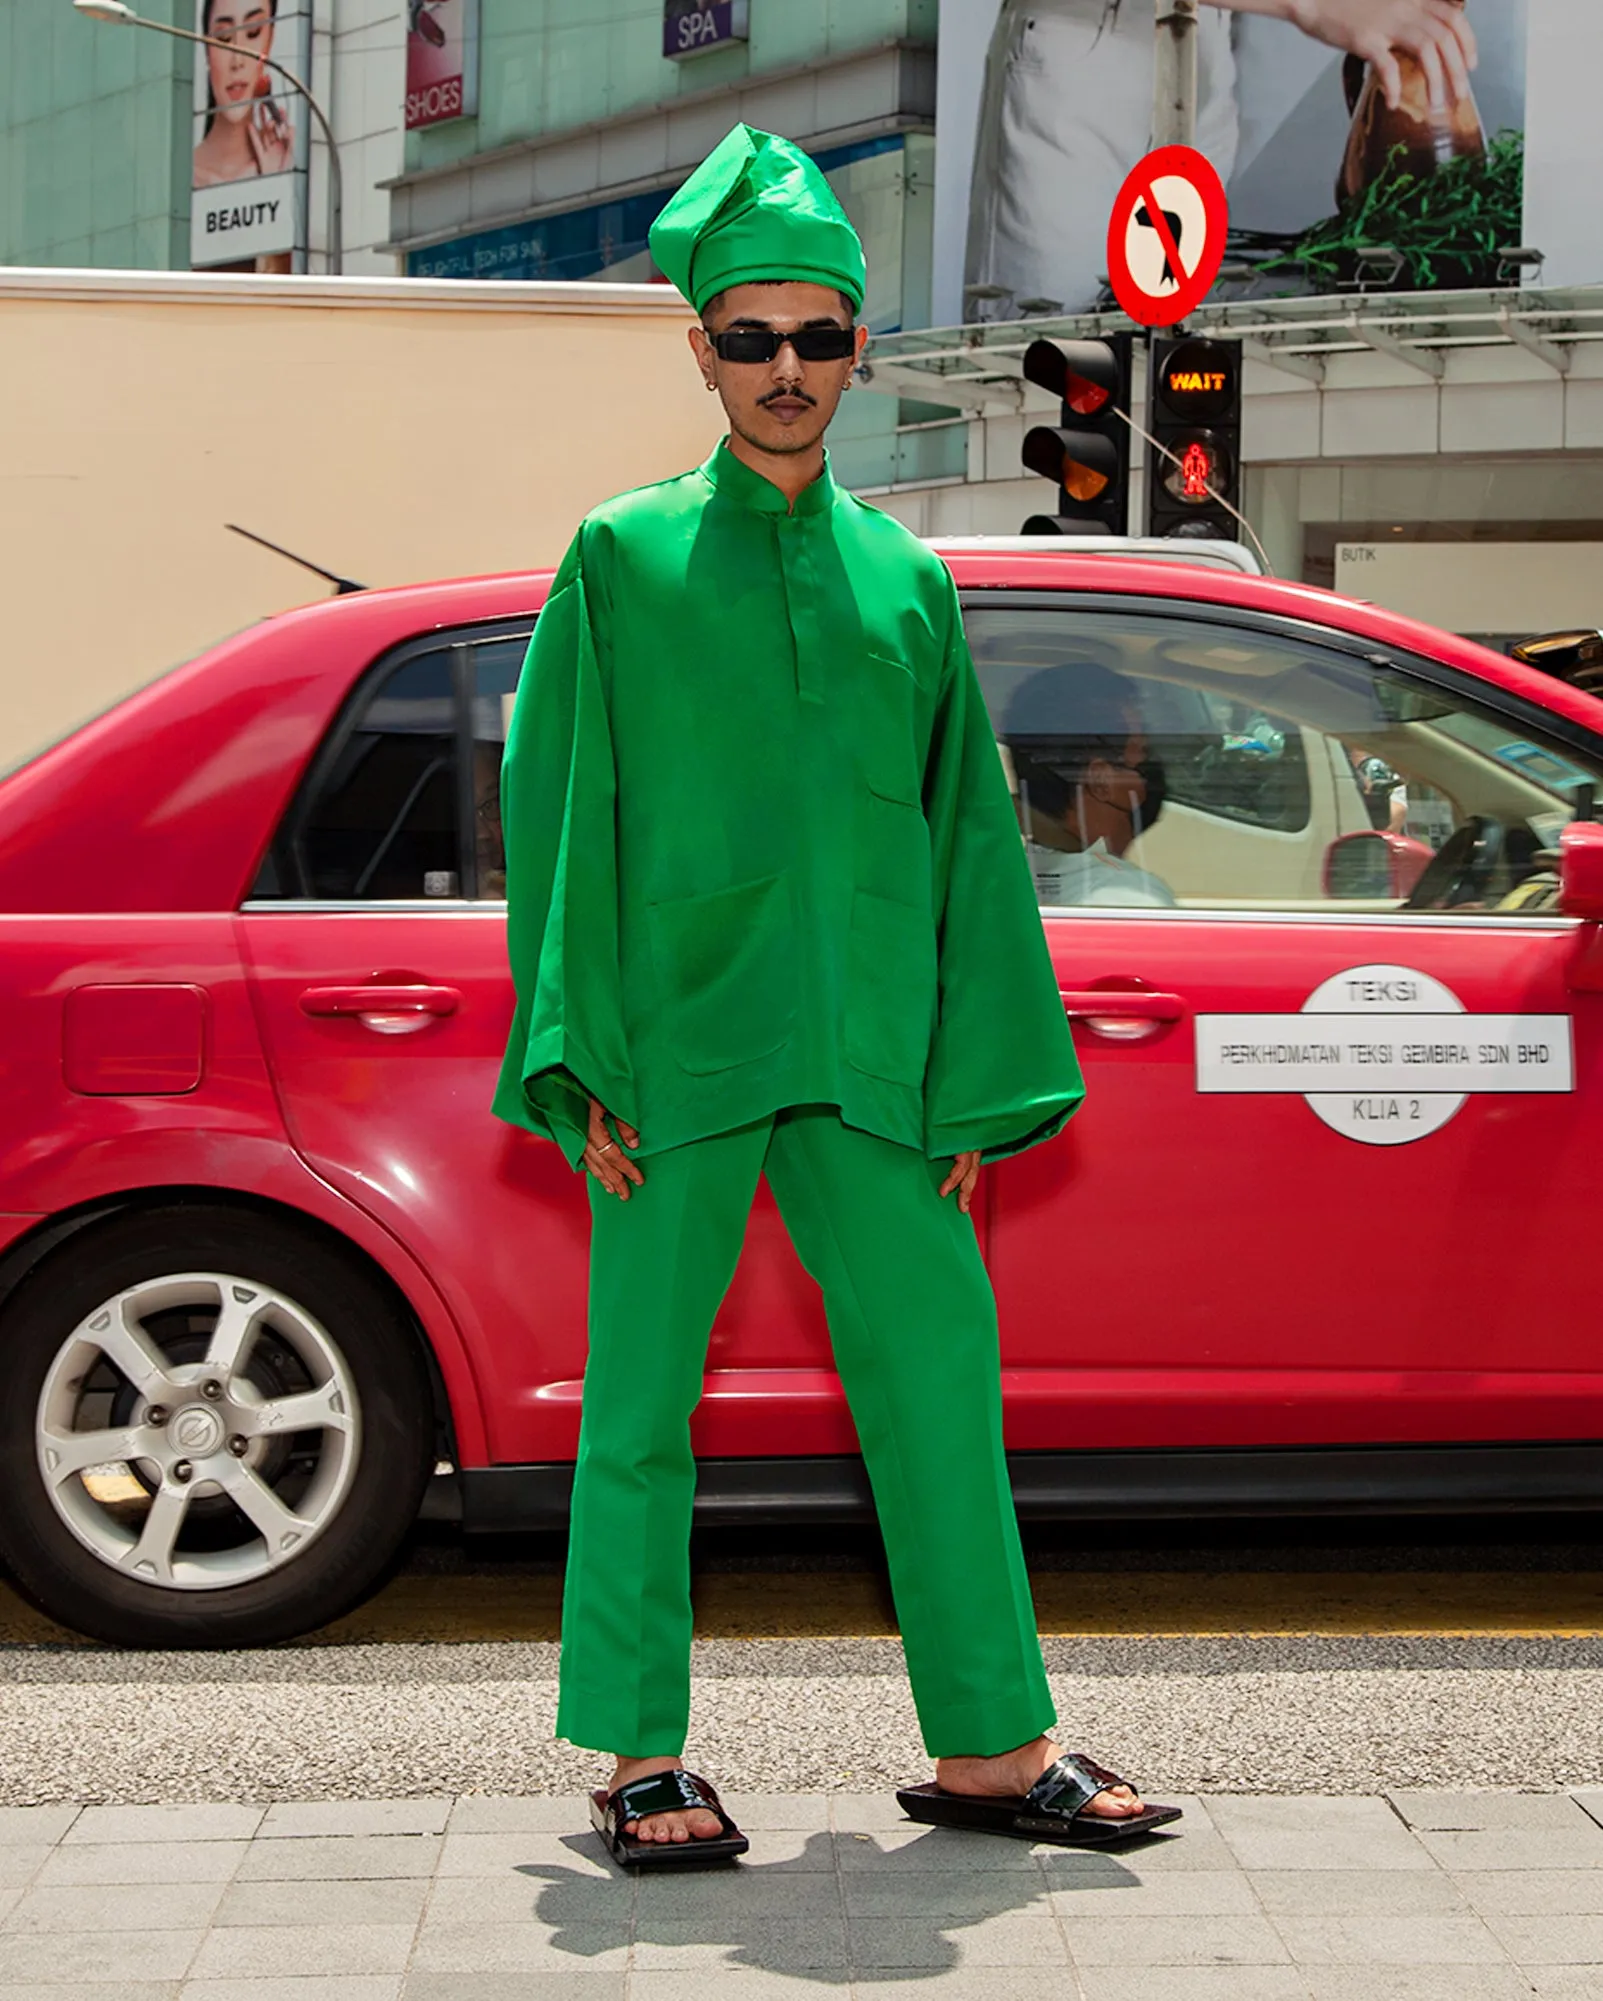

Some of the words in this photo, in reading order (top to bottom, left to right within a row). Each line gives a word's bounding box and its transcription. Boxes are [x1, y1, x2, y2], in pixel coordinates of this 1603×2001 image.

[678, 9, 718, 49] SPA
[406, 81, 460, 122] SHOES
[206, 200, 279, 233] BEAUTY
[1169, 372, 1226, 391] WAIT
[1345, 981, 1417, 1001] TEKSI
[1348, 1044, 1393, 1064] TEKSI
[1401, 1044, 1470, 1064] GEMBIRA
[1478, 1044, 1509, 1064] SDN
[1517, 1044, 1549, 1064] BHD
[1353, 1099, 1400, 1120] KLIA
[1409, 1099, 1420, 1119] 2
